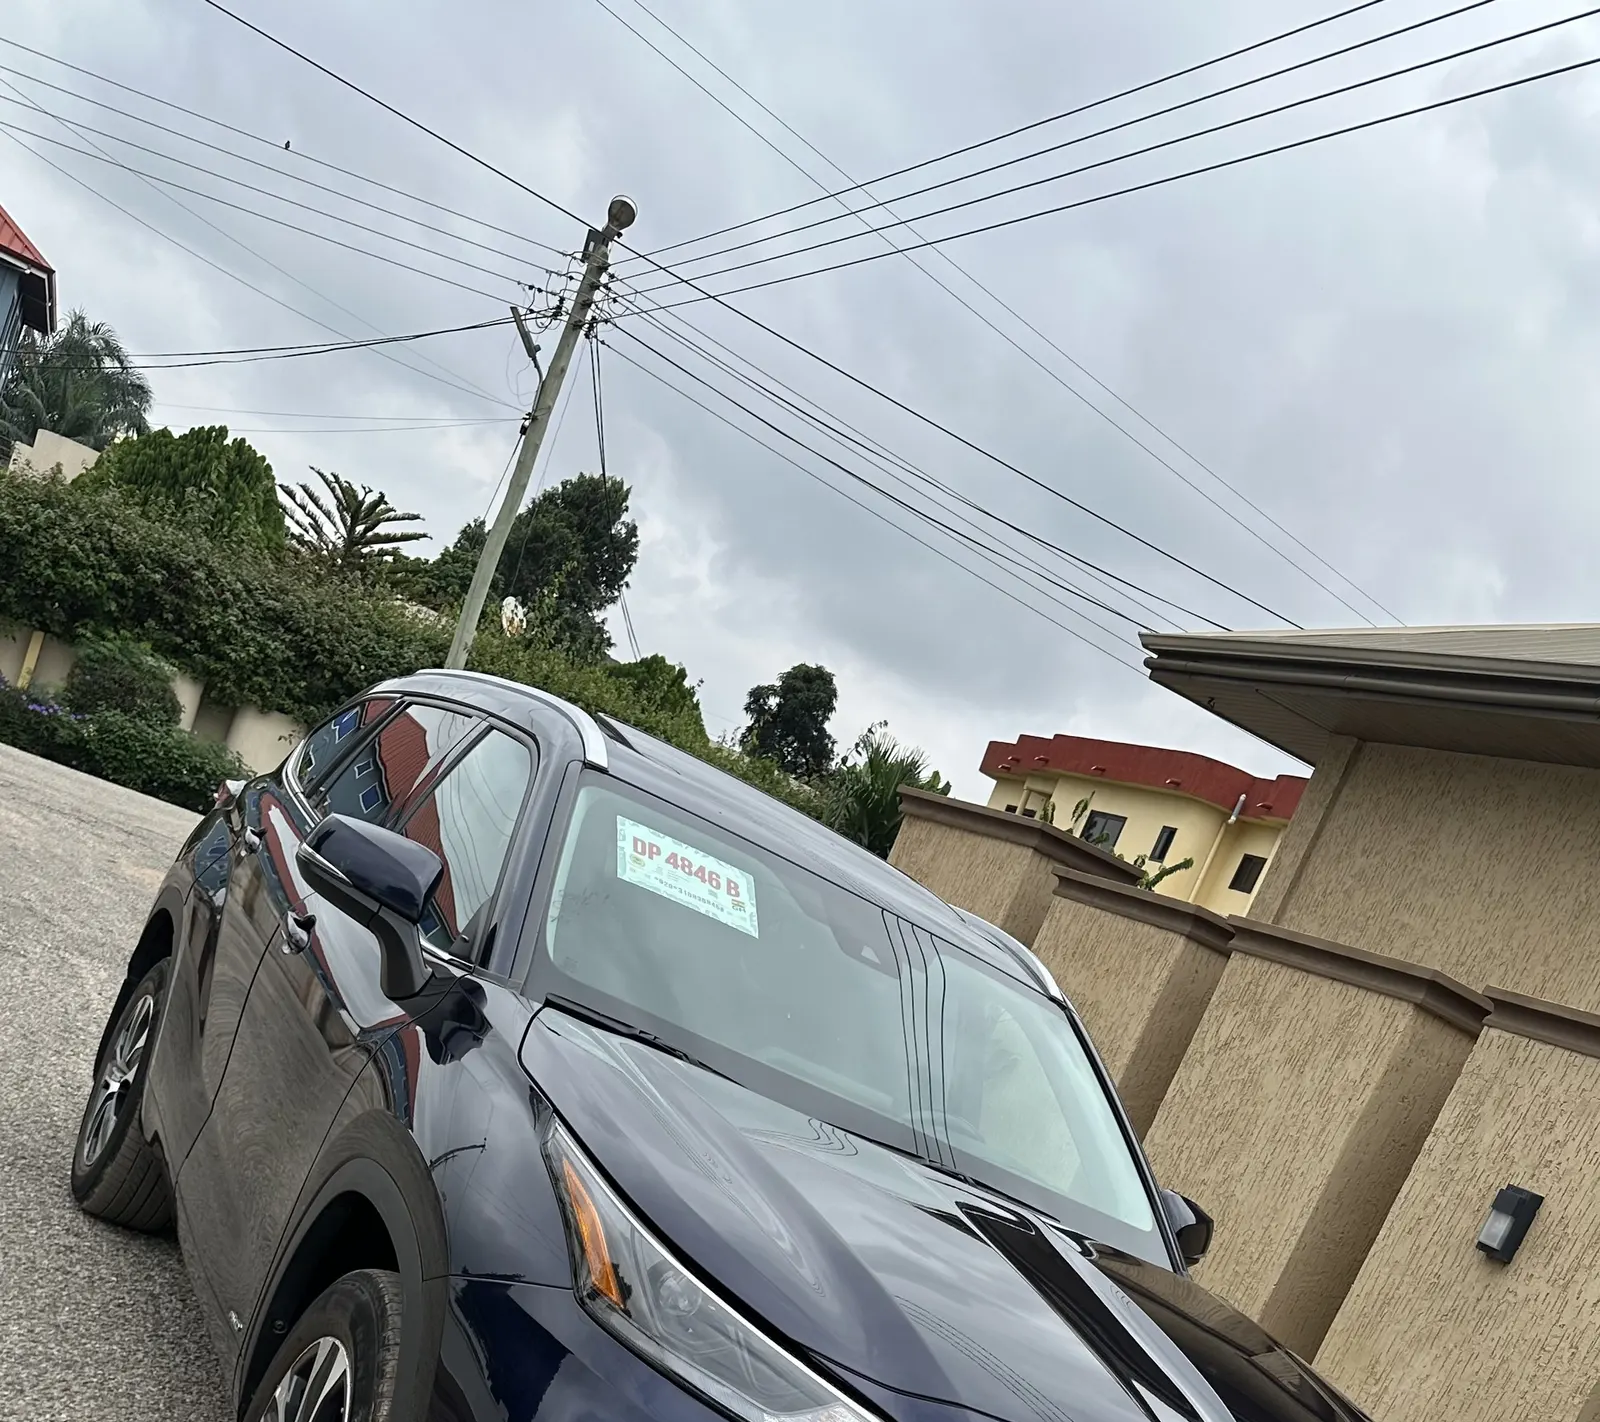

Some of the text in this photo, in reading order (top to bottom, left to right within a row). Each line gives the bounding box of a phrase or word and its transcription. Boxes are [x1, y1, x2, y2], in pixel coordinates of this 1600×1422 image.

[632, 836, 661, 860] DP
[665, 852, 721, 890] 4846
[726, 877, 741, 898] B
